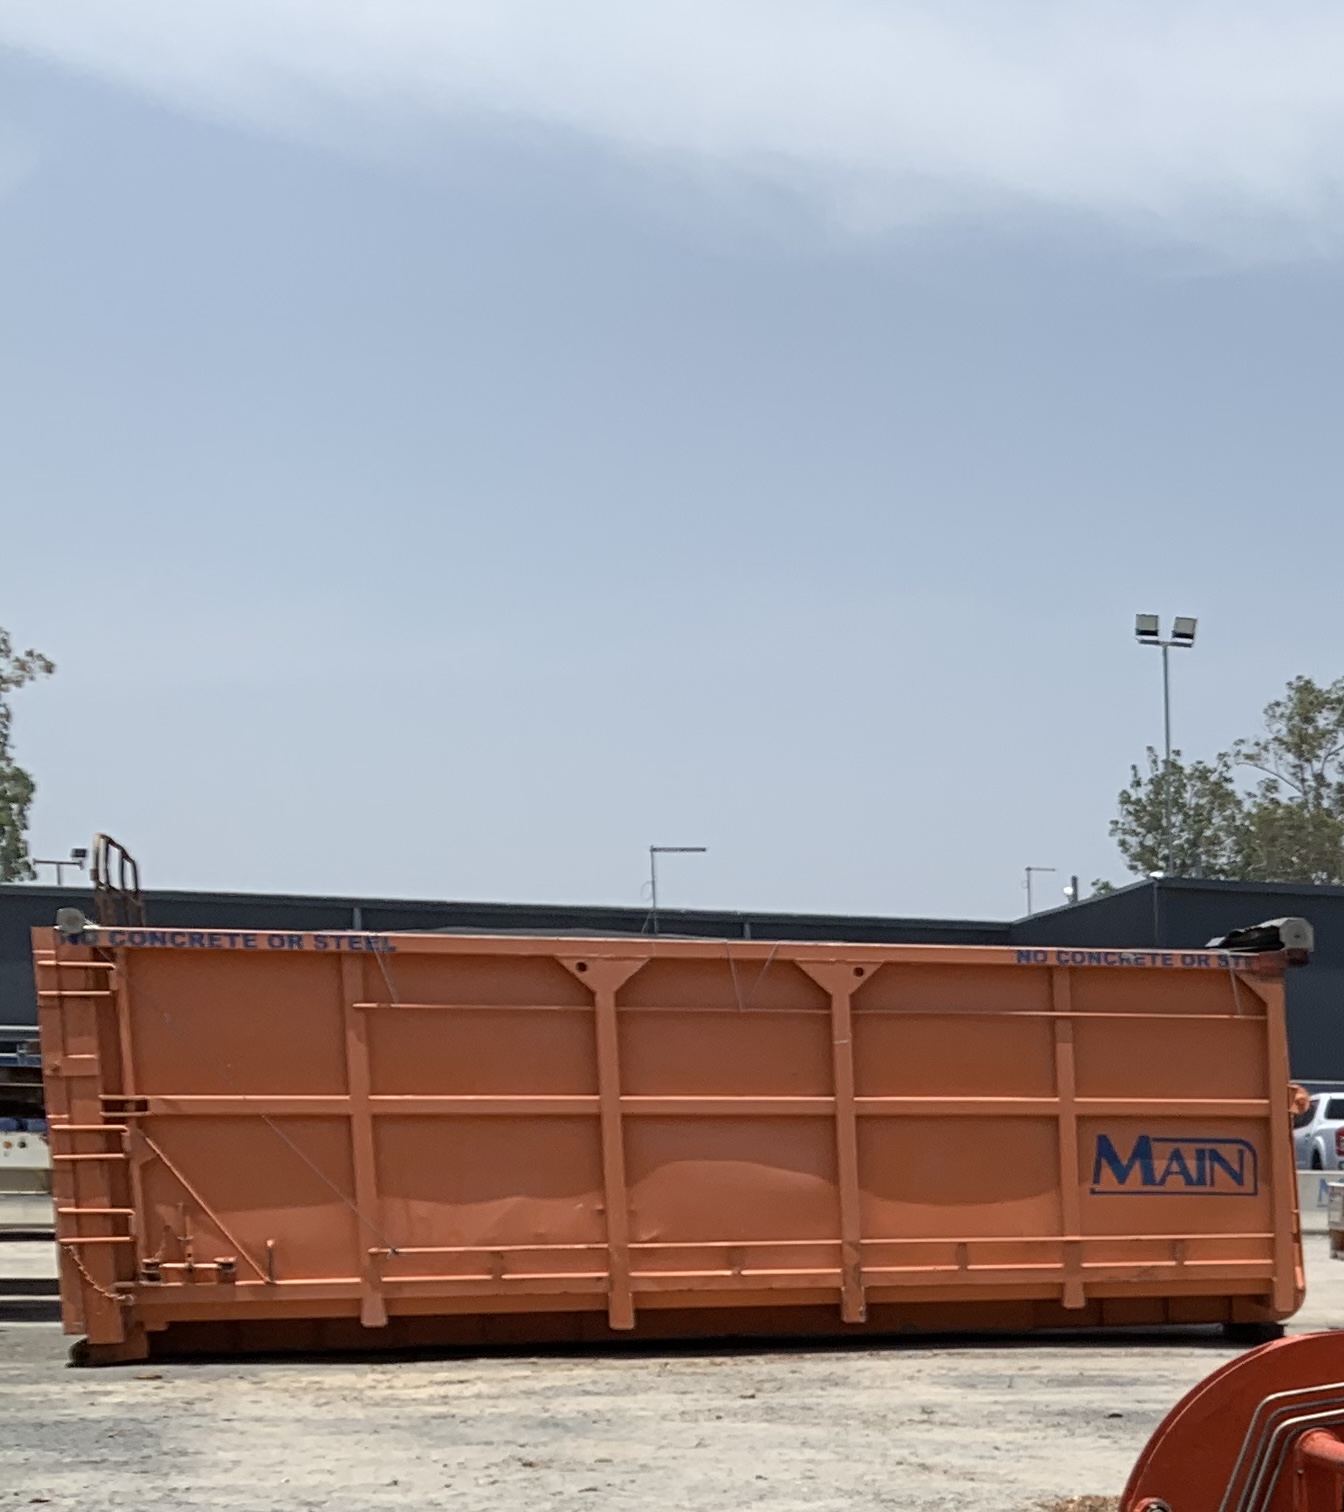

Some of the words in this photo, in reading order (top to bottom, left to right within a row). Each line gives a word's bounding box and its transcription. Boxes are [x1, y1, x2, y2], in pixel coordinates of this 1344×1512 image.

[108, 930, 259, 949] CONCRETE
[267, 933, 301, 950] OR
[313, 934, 396, 952] STEEL
[1016, 949, 1047, 965] NO
[1056, 949, 1174, 967] CONCRETE
[1181, 953, 1211, 968] OR
[1092, 1134, 1246, 1187] MAIN
